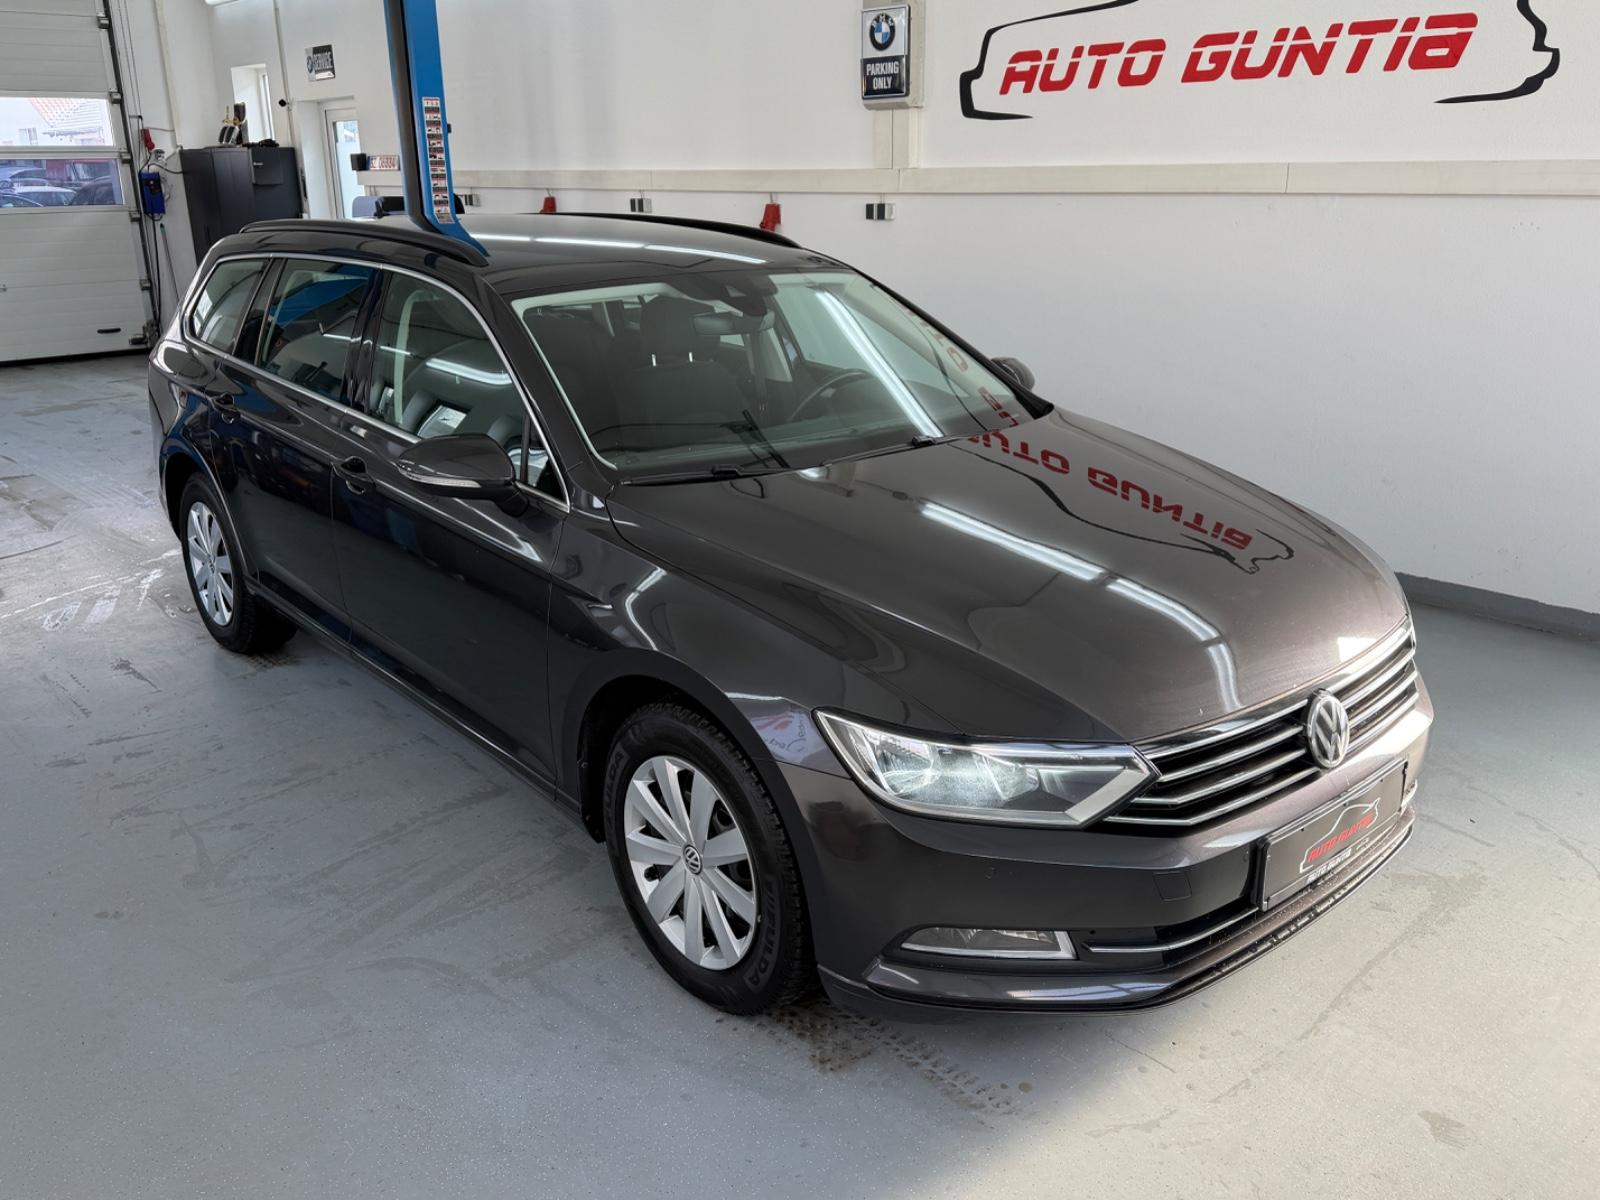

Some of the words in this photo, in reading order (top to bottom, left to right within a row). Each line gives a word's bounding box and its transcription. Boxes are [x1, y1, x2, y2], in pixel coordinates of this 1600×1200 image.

[866, 61, 899, 76] PARKING
[1000, 38, 1167, 95] AUTO
[873, 76, 893, 89] ONLY
